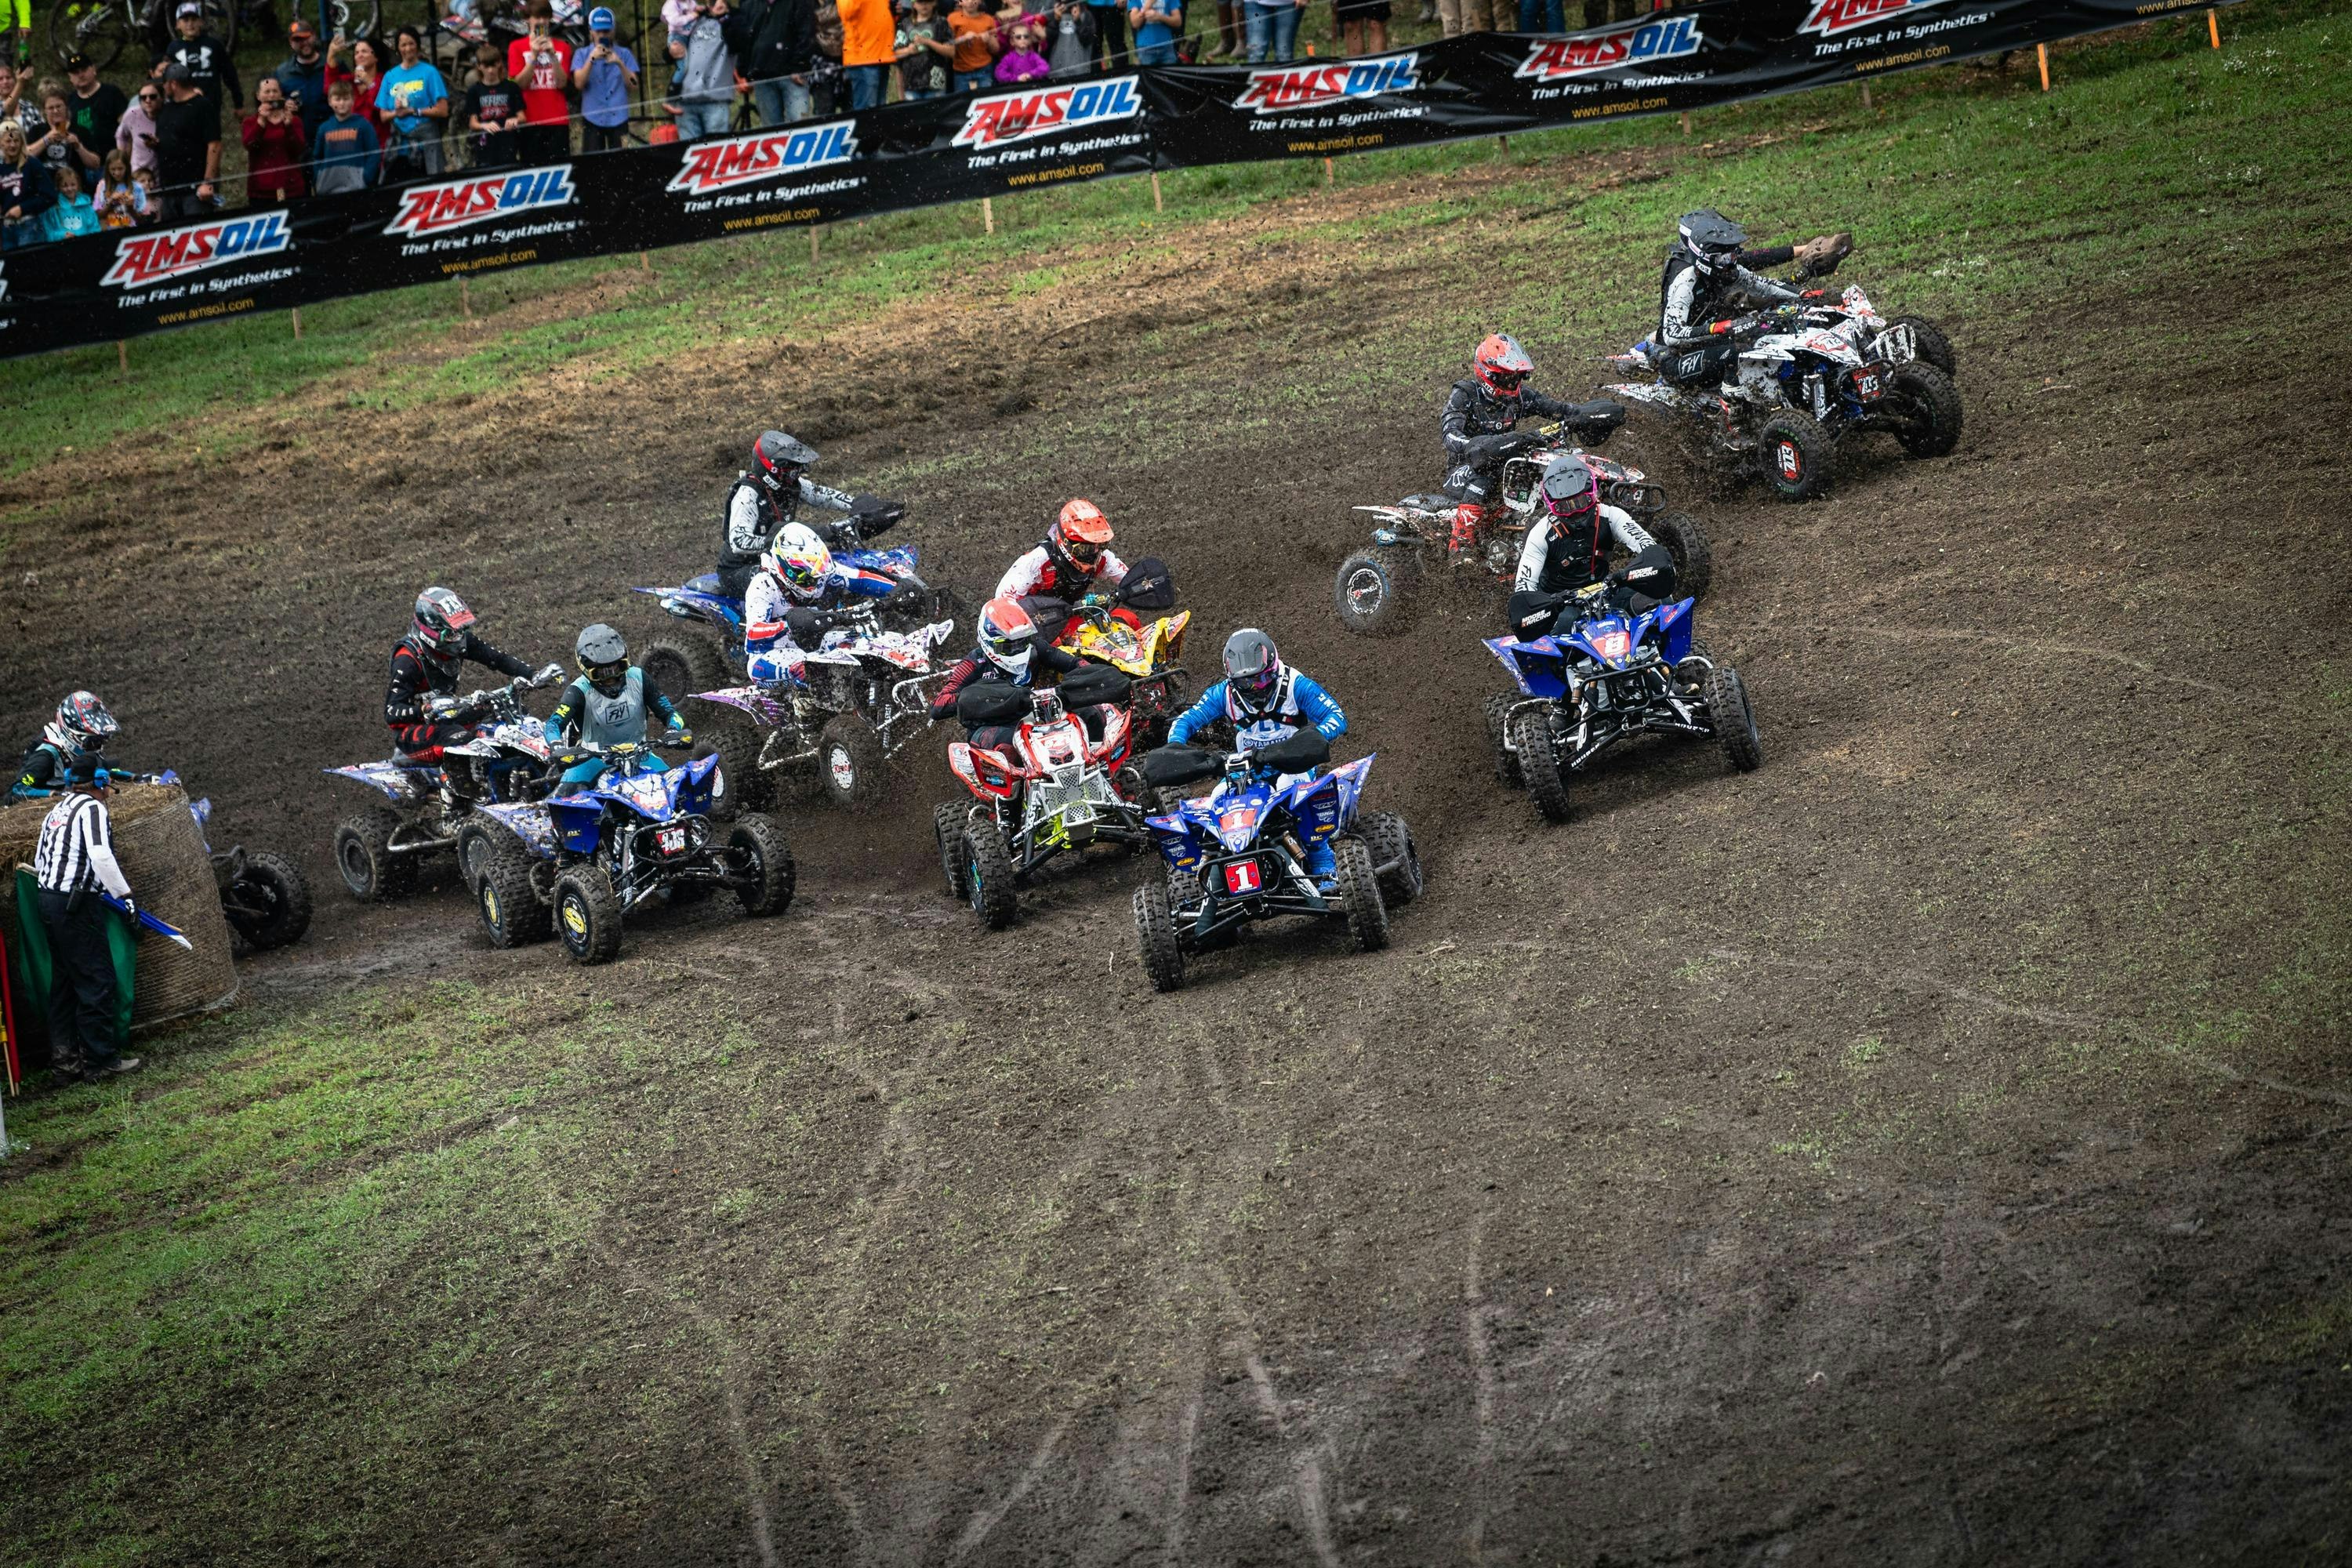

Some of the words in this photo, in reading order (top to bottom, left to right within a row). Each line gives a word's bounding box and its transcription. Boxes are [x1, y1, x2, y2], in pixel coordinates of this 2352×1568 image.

[1815, 43, 1842, 56] The
[1846, 34, 1882, 49] First
[1886, 30, 1900, 41] in
[1905, 12, 1987, 38] Synthetics
[1519, 16, 1700, 79] AMSOIL
[1856, 45, 1950, 71] www.amsoil.com
[1236, 55, 1416, 111] AMSOIL
[1531, 87, 1559, 100] The
[1563, 83, 1599, 97] First
[1603, 81, 1618, 93] in
[1622, 71, 1705, 91] Synthetics
[957, 78, 1139, 147] AMSOIL
[1249, 120, 1276, 132] The
[1279, 118, 1314, 129] First
[1319, 117, 1333, 127] in
[1338, 107, 1422, 126] Synthetics
[1572, 96, 1668, 118] www.amsoil.com
[967, 154, 996, 169] The
[998, 148, 1036, 164] First
[1040, 145, 1054, 156] in
[1058, 133, 1141, 156] Synthetics
[1287, 133, 1384, 152] www.amsoil.com
[673, 123, 855, 192] AMSOIL
[1007, 162, 1104, 187] www.amsoil.com
[390, 168, 572, 234] AMSOIL
[684, 201, 712, 212] The
[715, 193, 752, 209] First
[757, 190, 770, 201] in
[774, 176, 858, 201] Synthetics
[724, 208, 820, 230] www.amsoil.com
[107, 212, 289, 285] AMSOIL
[401, 243, 428, 256] The
[432, 236, 468, 251] First
[473, 233, 486, 245] in
[492, 219, 576, 243] Synthetics
[441, 249, 536, 274] www.amsoil.com
[118, 295, 145, 308] The
[150, 286, 184, 303] First
[191, 281, 204, 293] in
[209, 268, 292, 292] Synthetics
[158, 298, 254, 325] www.amsoil.com
[1681, 353, 1700, 376] FLY
[1780, 444, 1797, 473] 703
[1628, 566, 1654, 576] MOOSE
[1631, 569, 1658, 581] RACING
[1521, 609, 1546, 622] MOOSE
[1525, 611, 1552, 626] RACING
[608, 706, 626, 721] FLY
[1232, 812, 1245, 829] 1
[1235, 866, 1253, 891] 1
